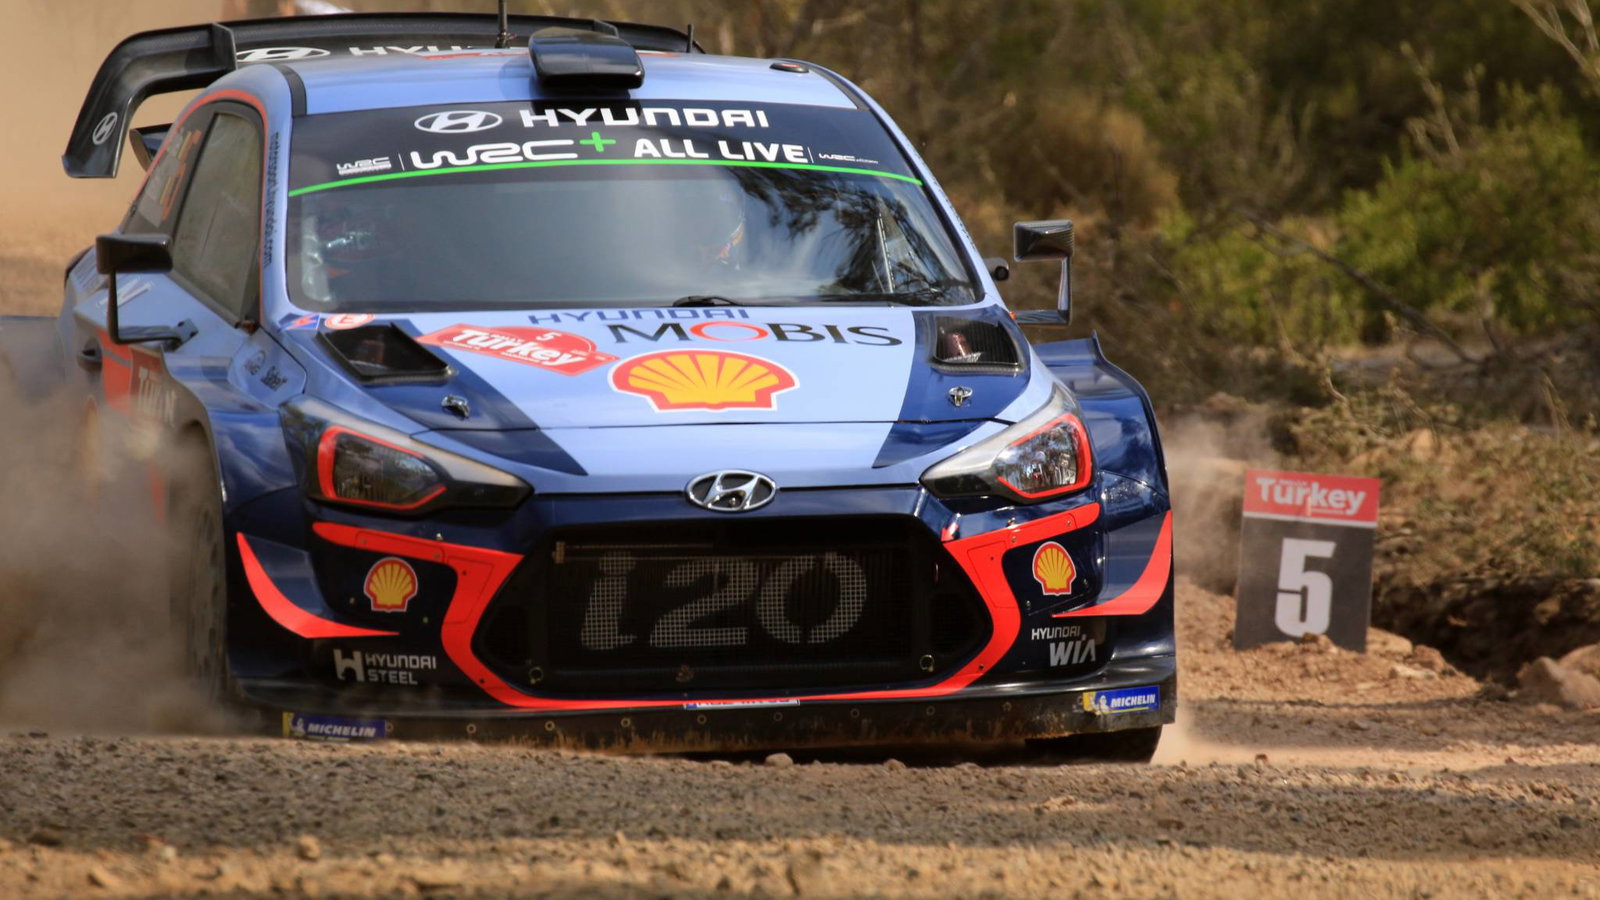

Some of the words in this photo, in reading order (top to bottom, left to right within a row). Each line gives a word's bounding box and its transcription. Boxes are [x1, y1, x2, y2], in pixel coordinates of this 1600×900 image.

[519, 107, 769, 128] HYUNDAI
[634, 138, 709, 159] ALL
[718, 140, 808, 164] LIVE
[528, 308, 750, 324] HYUNDAI
[535, 332, 563, 342] 5
[606, 321, 902, 346] MOBIS
[1274, 537, 1337, 637] 5
[580, 551, 868, 650] i20
[1031, 626, 1081, 640] HYUNDAI
[365, 653, 437, 669] HYUNDAI
[367, 669, 418, 685] STEEL
[1110, 694, 1156, 708] MICHELIN
[307, 723, 377, 738] MICHELIN
